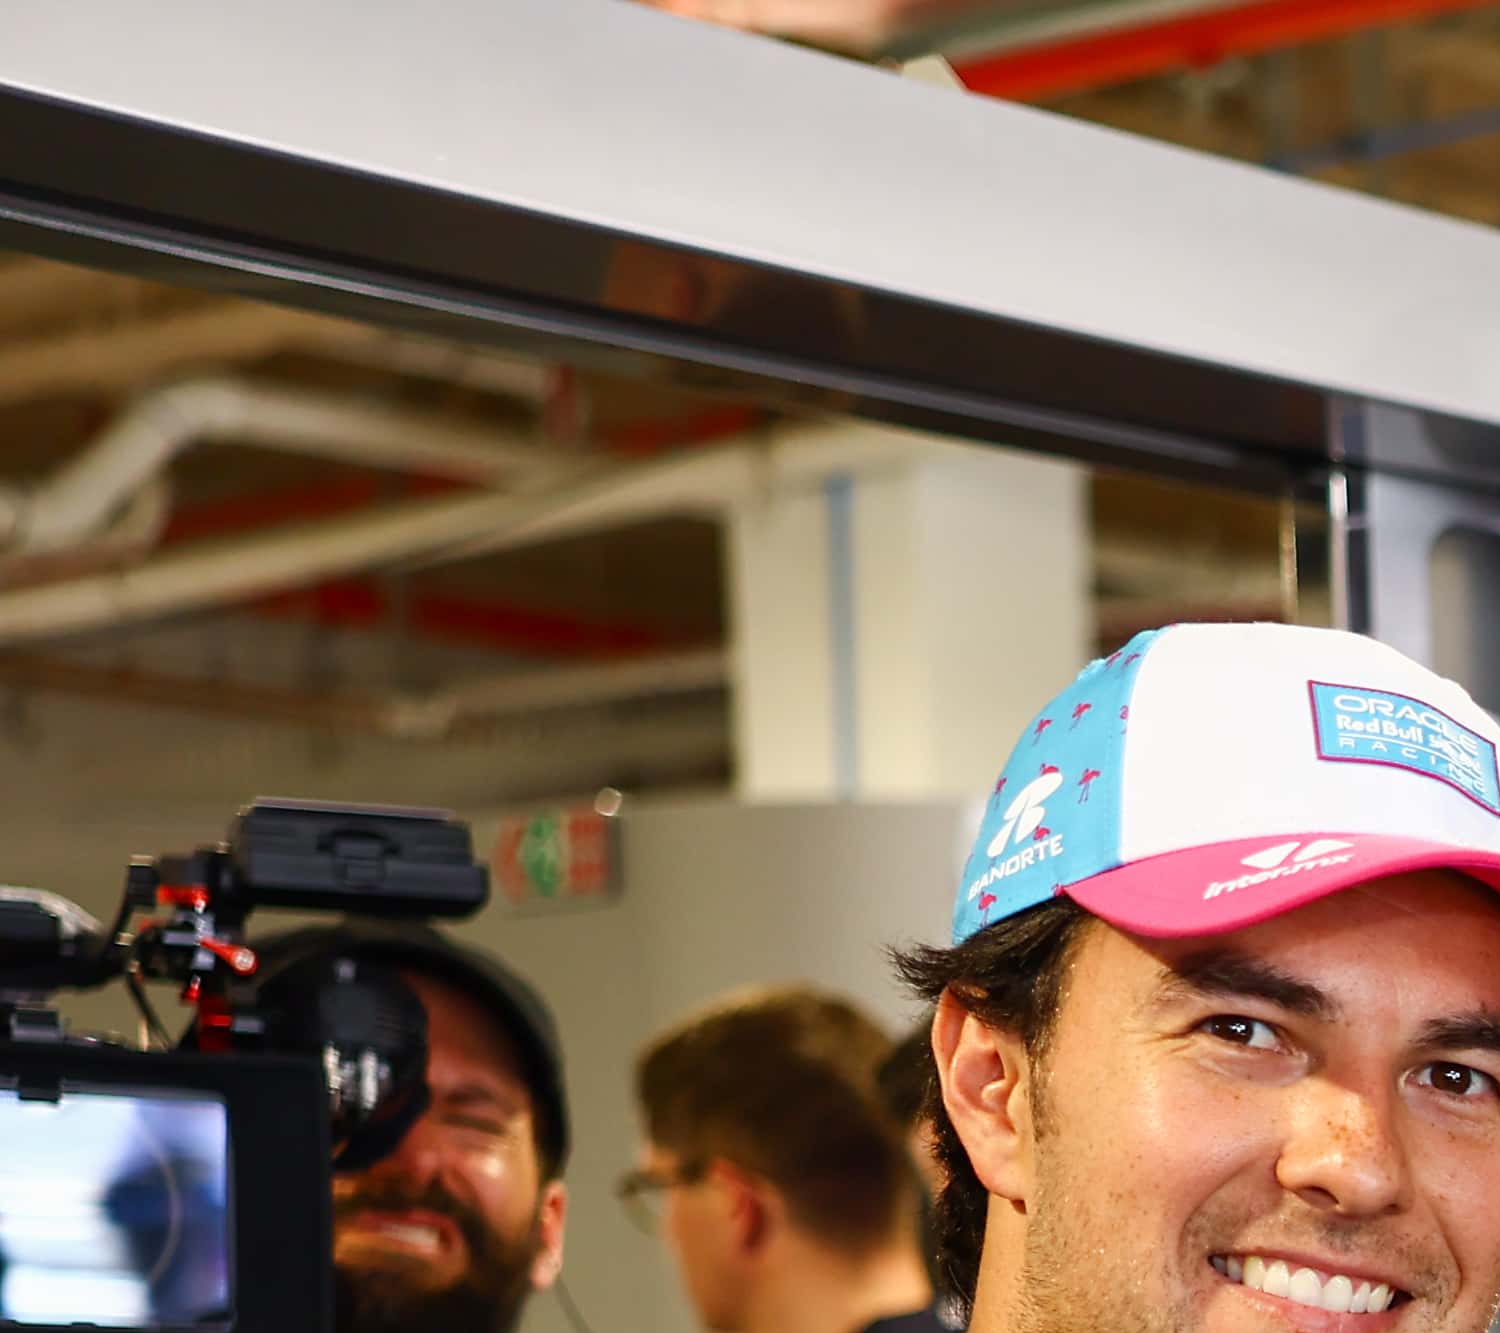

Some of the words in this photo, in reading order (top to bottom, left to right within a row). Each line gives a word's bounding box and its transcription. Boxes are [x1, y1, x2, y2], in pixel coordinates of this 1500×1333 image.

[1334, 694, 1478, 755] ORACLE
[1336, 715, 1378, 737] Red
[1380, 718, 1424, 745] Bull
[967, 834, 1064, 902] BANORTE
